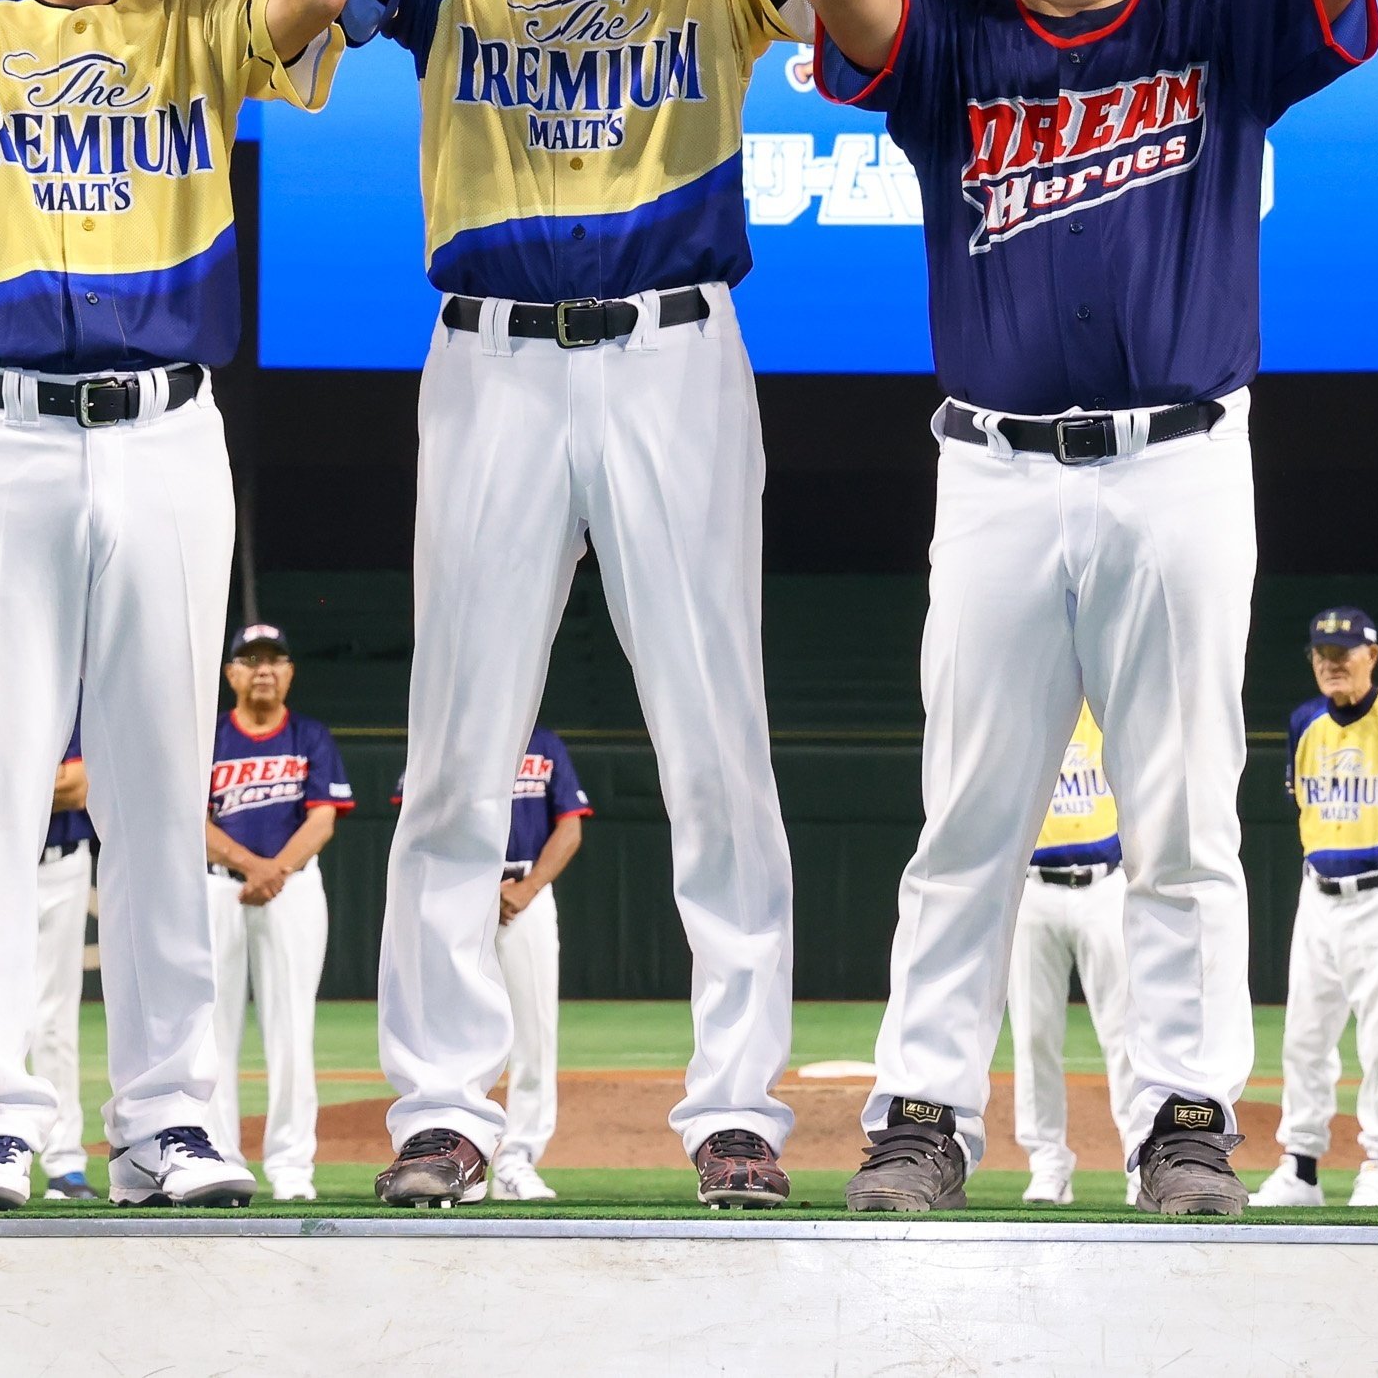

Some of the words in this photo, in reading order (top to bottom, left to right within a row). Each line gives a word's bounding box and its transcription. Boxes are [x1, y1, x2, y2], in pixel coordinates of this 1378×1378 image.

[3, 53, 151, 108] The
[963, 68, 1203, 182] DREAM
[35, 177, 132, 212] MALT'S
[986, 135, 1187, 234] Heroes
[905, 1101, 942, 1119] ZETT
[1177, 1108, 1211, 1122] ZETT
